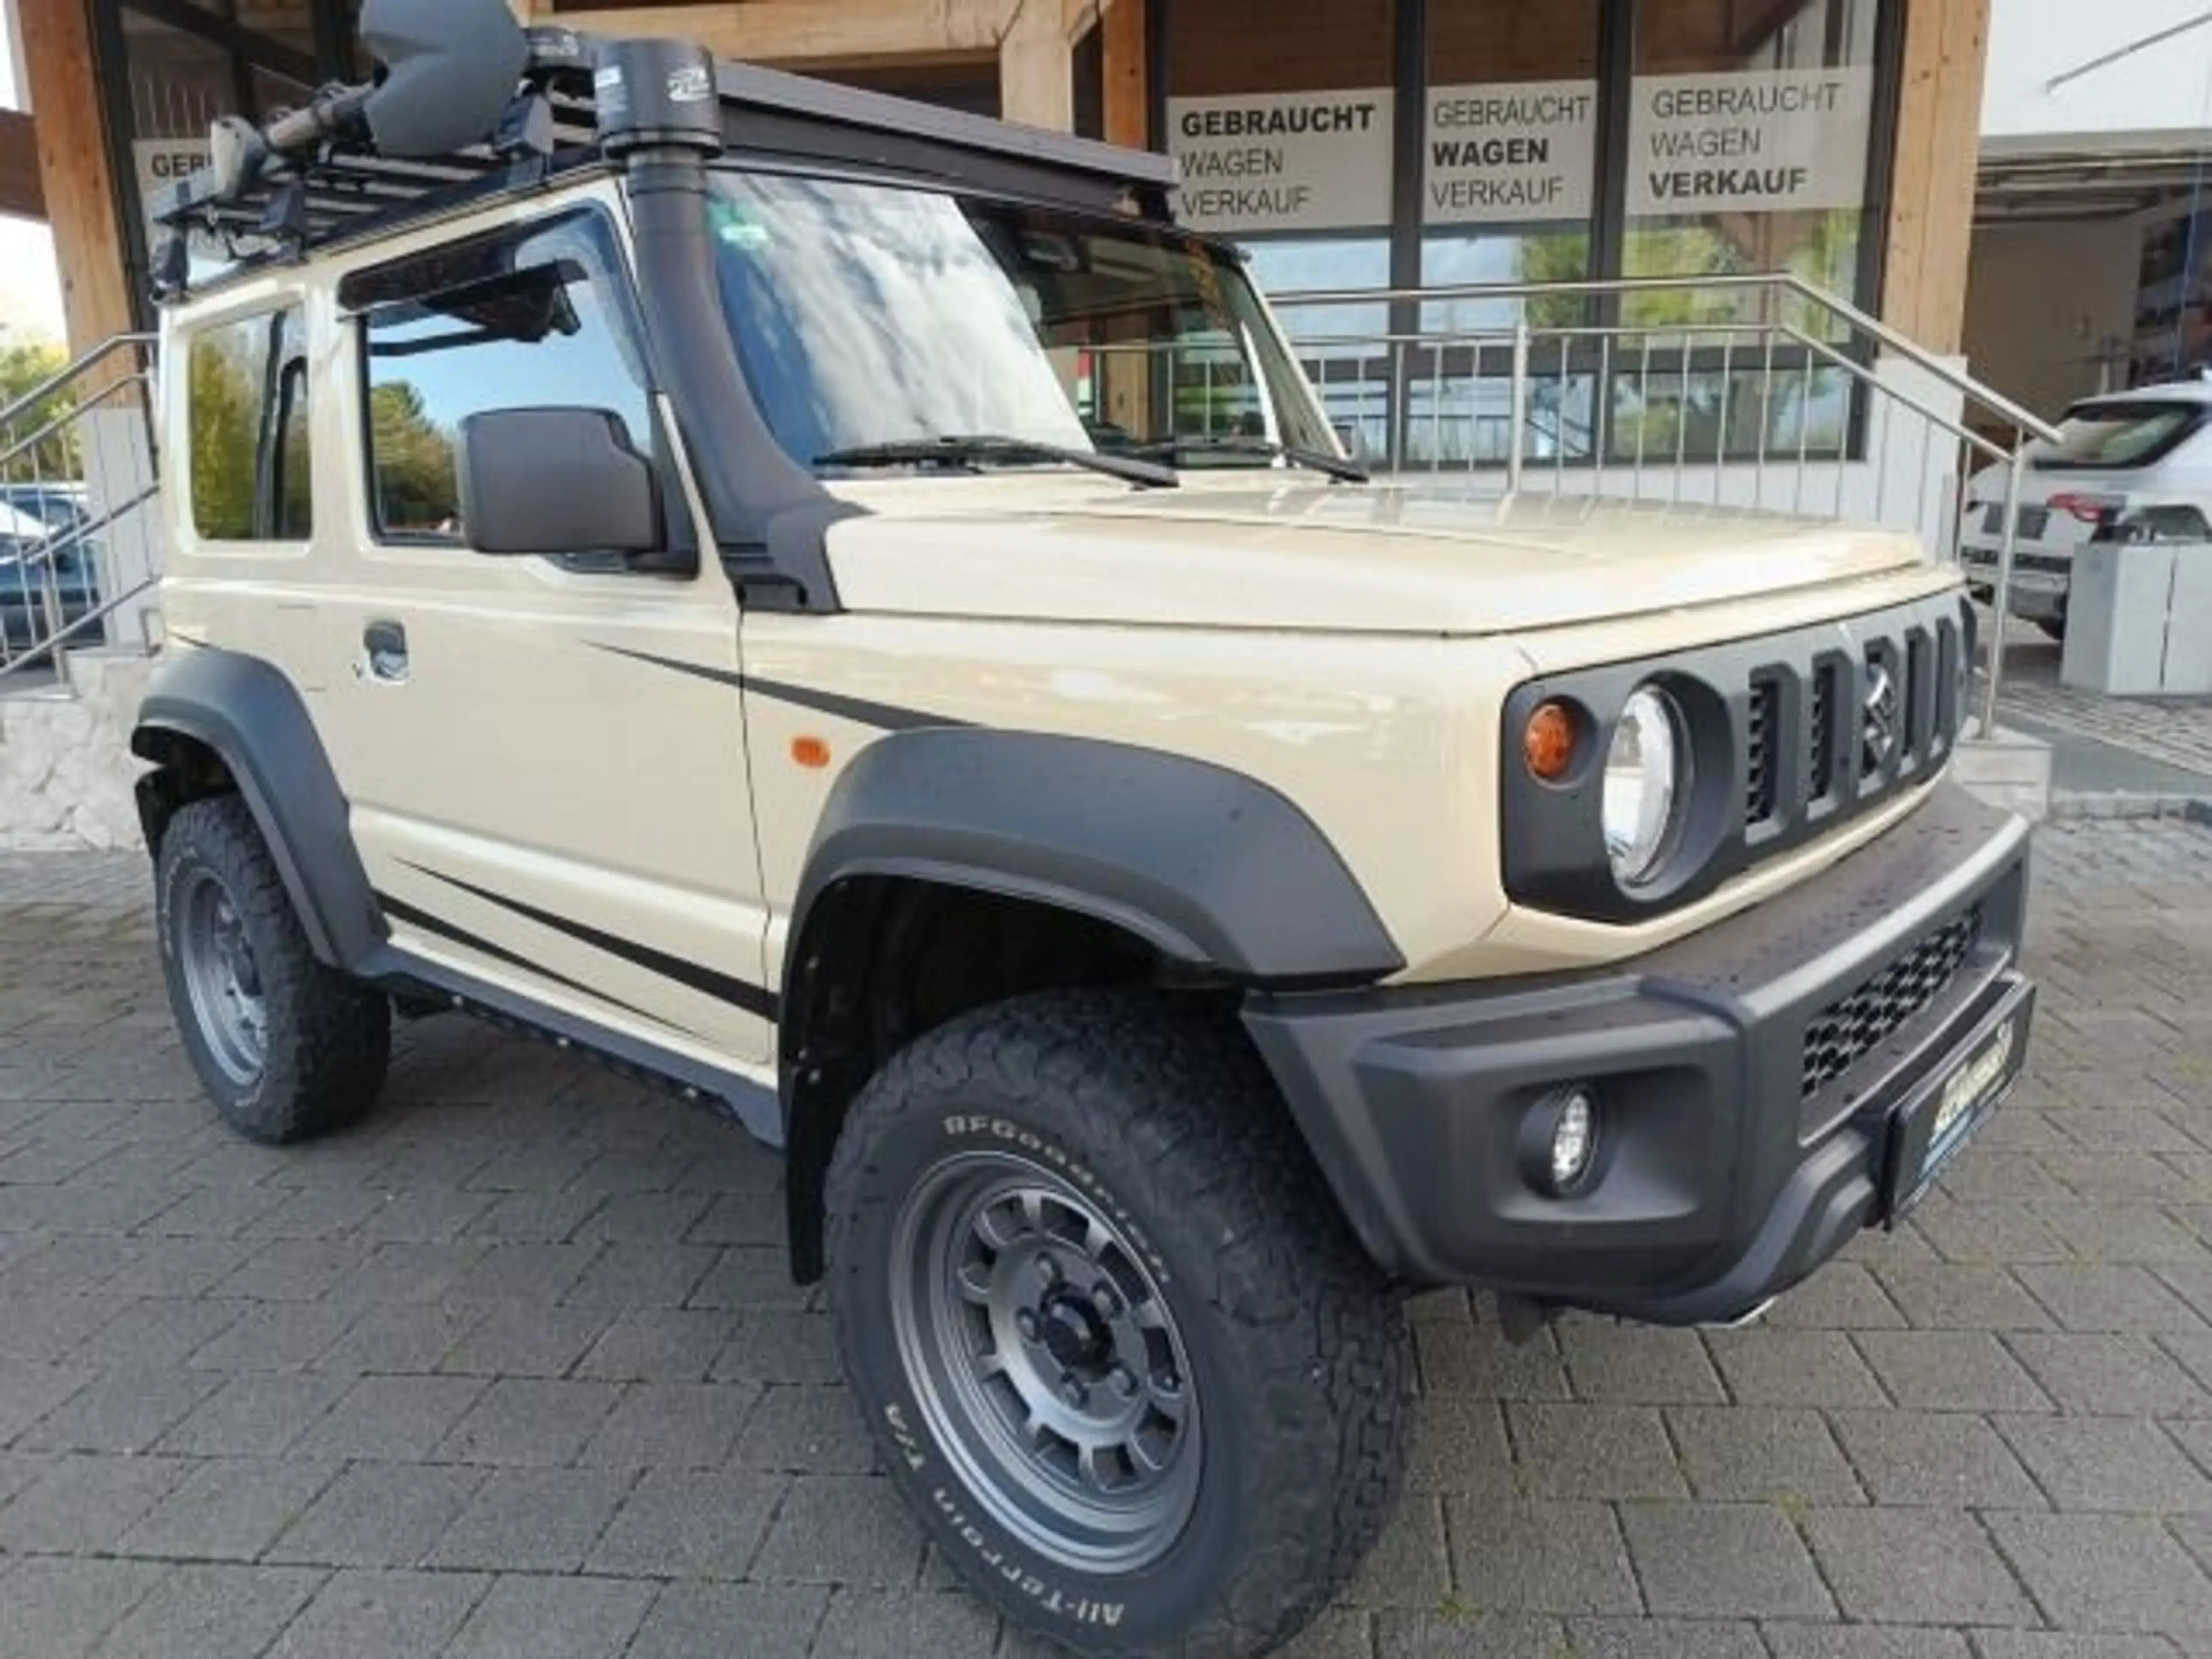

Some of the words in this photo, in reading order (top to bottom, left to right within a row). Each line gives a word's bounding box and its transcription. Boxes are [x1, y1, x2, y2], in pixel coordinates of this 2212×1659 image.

[1432, 96, 1591, 128] GEBRAUCHT
[1652, 82, 1842, 119] GEBRAUCHT
[1181, 103, 1376, 137] GEBRAUCHT
[1431, 138, 1549, 167] WAGEN
[1650, 127, 1762, 158] WAGEN
[1181, 148, 1285, 177] WAGEN
[1430, 176, 1564, 209] VERKAUF
[1648, 166, 1808, 199] VERKAUF
[1180, 185, 1311, 217] VERKAUF
